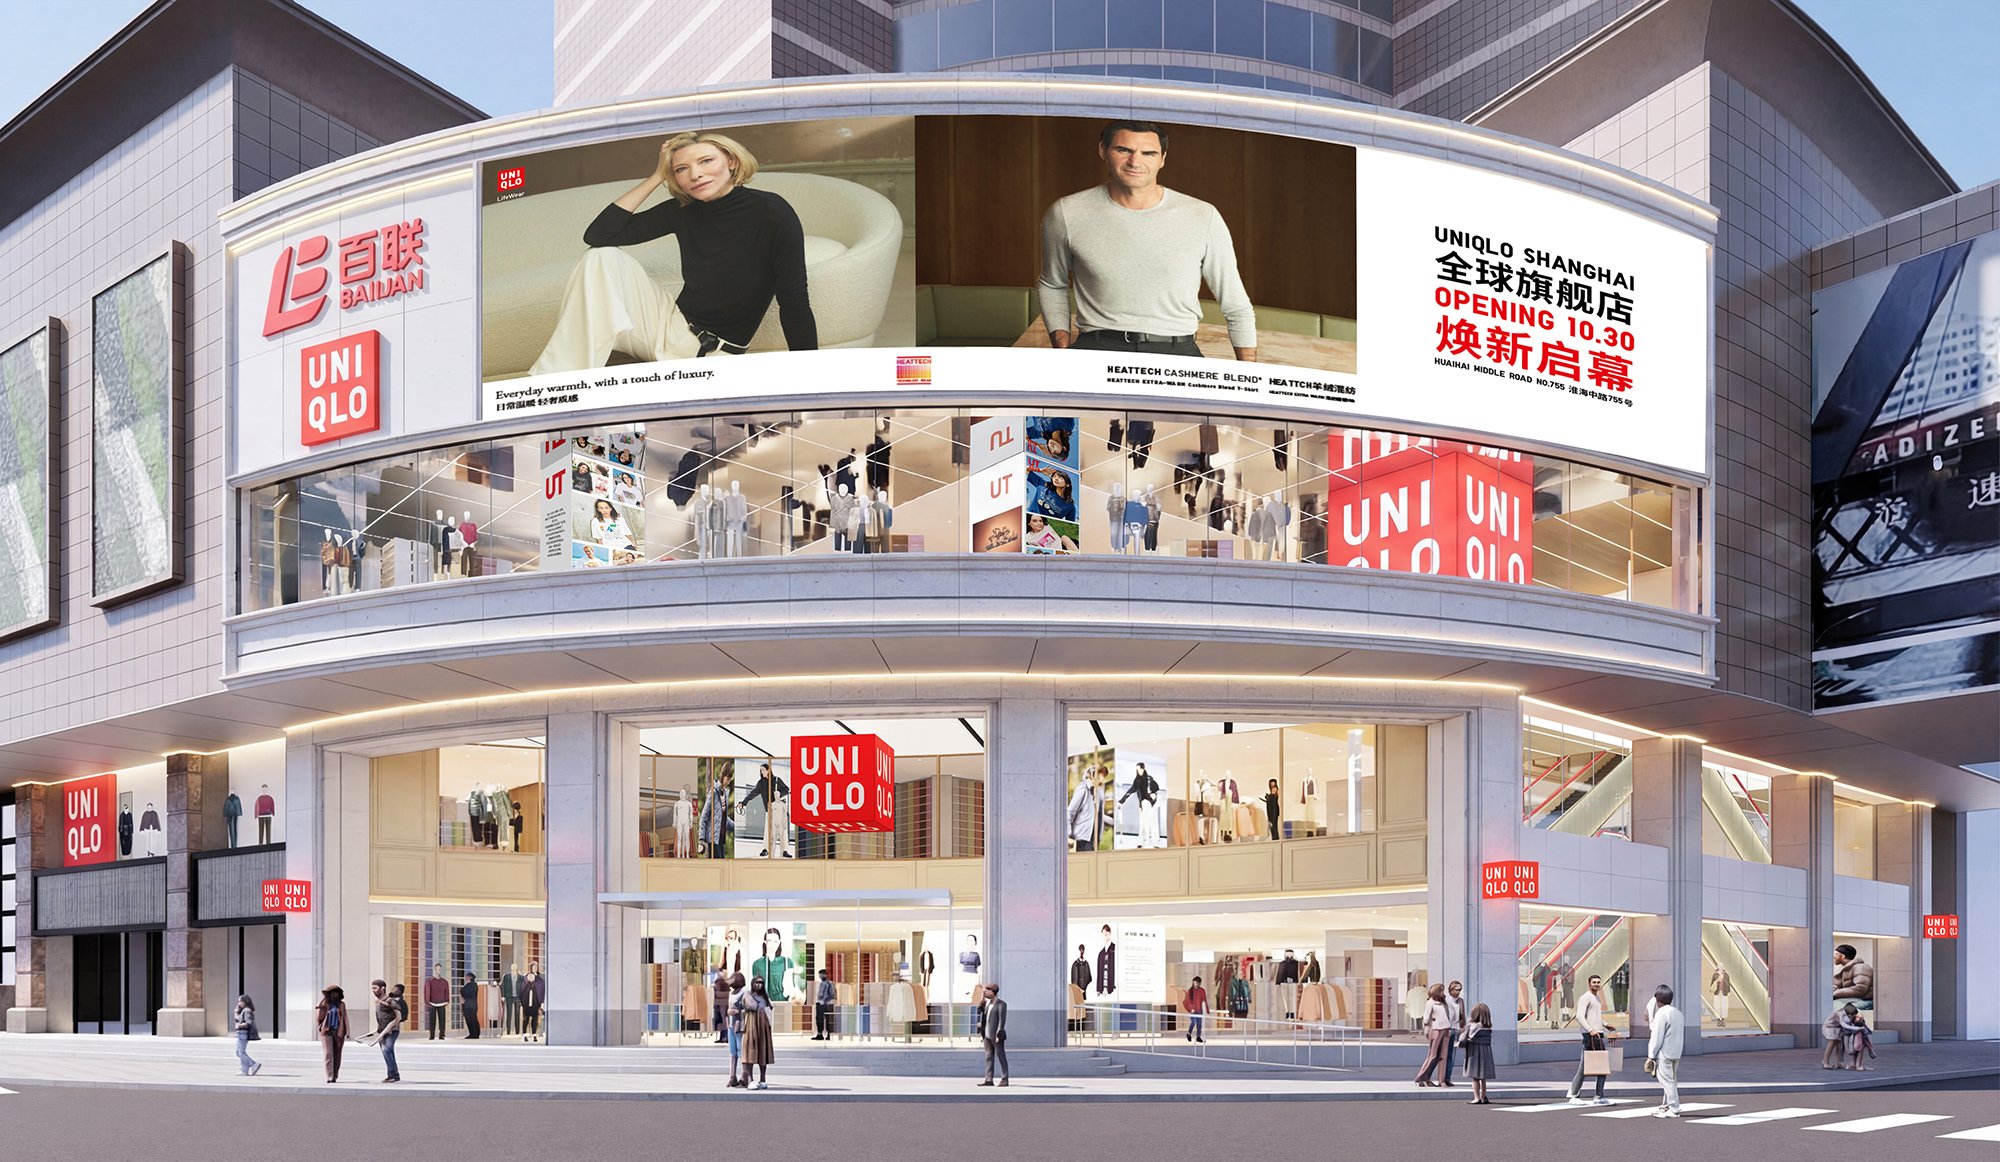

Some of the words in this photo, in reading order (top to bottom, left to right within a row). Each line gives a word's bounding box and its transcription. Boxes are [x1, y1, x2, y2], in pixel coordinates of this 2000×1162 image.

[501, 170, 520, 180] UNI
[501, 178, 522, 189] QLO
[497, 192, 525, 202] LifeWear
[338, 218, 423, 285] 百联
[1435, 226, 1513, 258] UNIQLO
[1524, 248, 1634, 291] SHANGHAI
[340, 269, 424, 310] BAILIAN
[1435, 250, 1634, 326] 全球旗舰店
[1435, 287, 1554, 330] OPENING
[1568, 316, 1634, 351] 10.30
[309, 344, 362, 389] UNI
[1436, 315, 1633, 392] 焕新启幕
[496, 387, 544, 400] Everyday
[547, 380, 591, 393] warmth,
[595, 375, 618, 387] with
[622, 377, 628, 385] a
[631, 373, 661, 384] touch
[664, 370, 678, 380] of
[679, 369, 715, 380] luxury.
[1107, 365, 1161, 376] HEATTECH
[1164, 368, 1219, 380] CASHMERE
[1434, 357, 1470, 370] HUAIHAI
[1474, 365, 1505, 378] MIDDLE
[1509, 372, 1533, 383] ROAD
[1536, 377, 1565, 390] NO.755
[309, 385, 367, 433] QLO
[1873, 411, 2000, 465] ADIZE
[545, 468, 566, 500] UT
[990, 473, 1013, 499] UT
[1343, 479, 1430, 546] UNI
[1466, 474, 1519, 542] UNI
[801, 746, 858, 775] UNI
[877, 748, 891, 784] UNI
[68, 787, 98, 820] UNI
[801, 782, 865, 816] QLO
[877, 784, 892, 818] QLO
[68, 824, 101, 860] QLO
[1486, 866, 1506, 880] UNI
[1486, 881, 1508, 896] QLO
[1514, 866, 1533, 879] UNI
[1514, 881, 1535, 895] QLO
[264, 884, 278, 895] UNI
[264, 896, 279, 909] QLO
[285, 884, 306, 895] UNI
[285, 896, 307, 909] QLO
[1927, 918, 1945, 926] UNI
[1927, 927, 1946, 936] QLO
